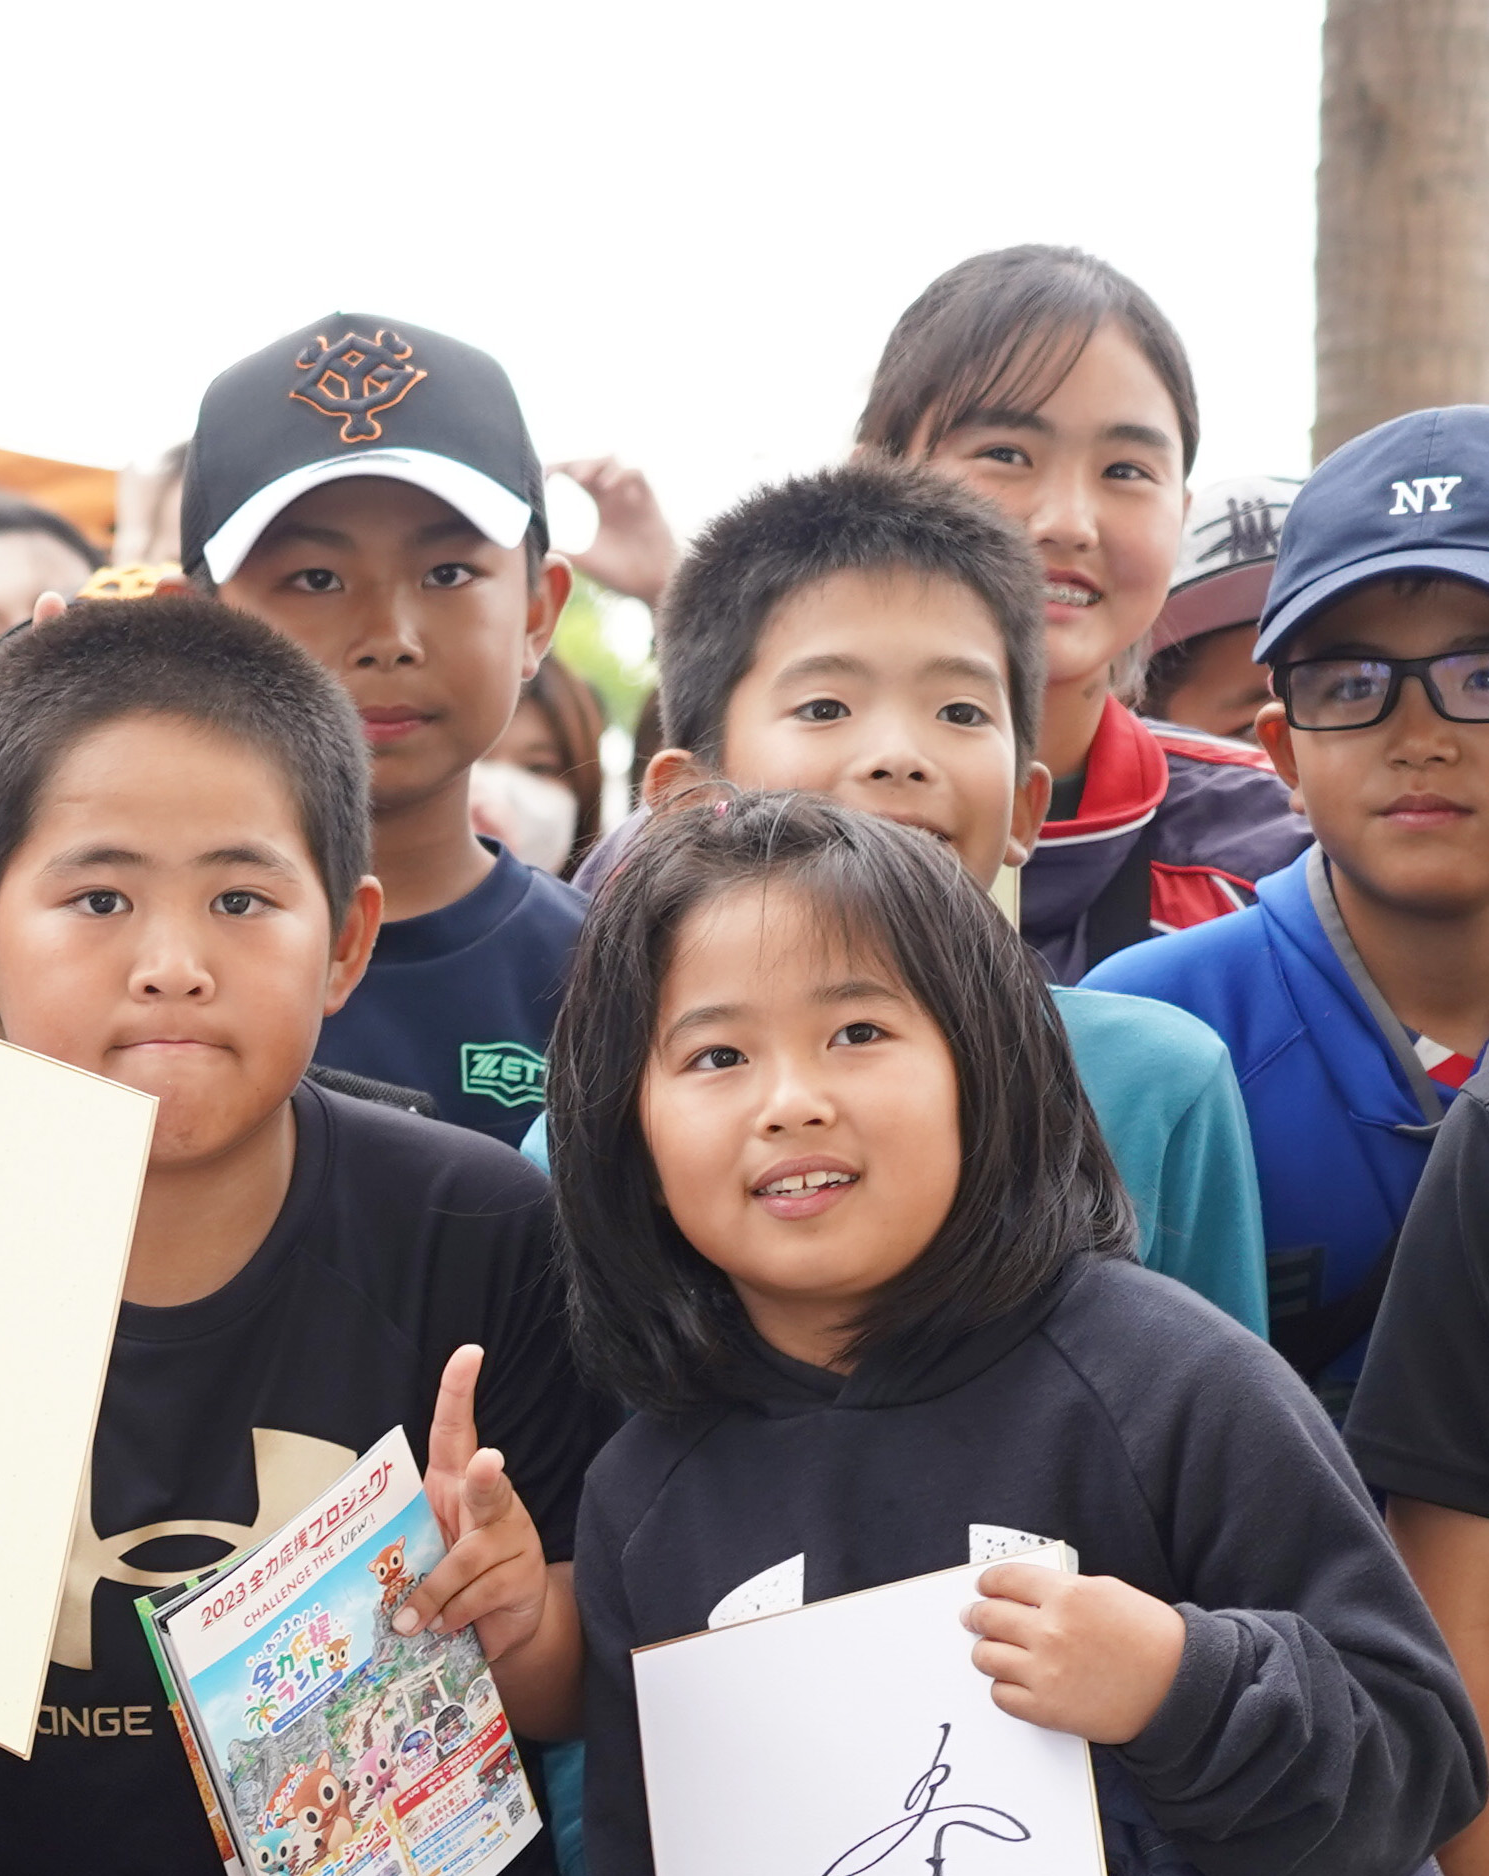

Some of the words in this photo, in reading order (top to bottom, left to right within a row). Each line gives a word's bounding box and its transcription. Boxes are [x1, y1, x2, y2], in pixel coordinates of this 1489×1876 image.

[1389, 476, 1462, 515] NY
[470, 1053, 545, 1084] ZET
[242, 1563, 313, 1630] CHALLENGE
[311, 1543, 336, 1572] THE
[247, 1607, 336, 1701] 全力応援
[273, 1647, 329, 1711] ランド
